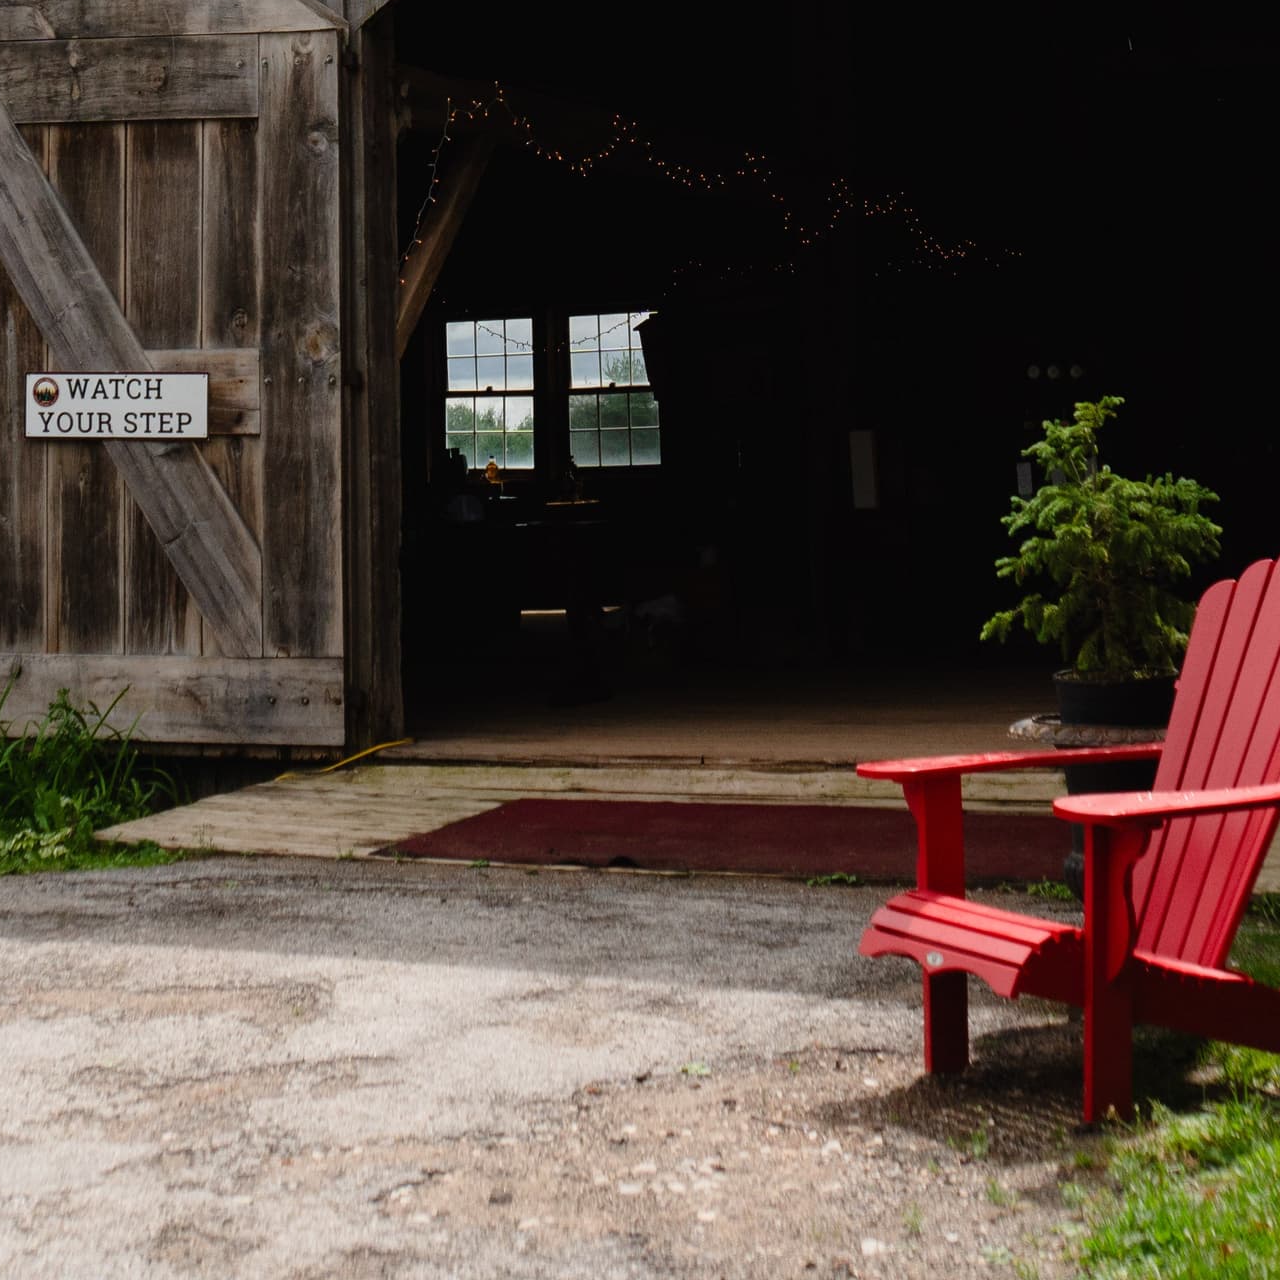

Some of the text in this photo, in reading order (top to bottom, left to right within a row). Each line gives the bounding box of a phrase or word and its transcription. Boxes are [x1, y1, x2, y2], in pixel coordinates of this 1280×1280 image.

[66, 378, 163, 400] WATCH
[38, 412, 193, 434] YOUR STEP
